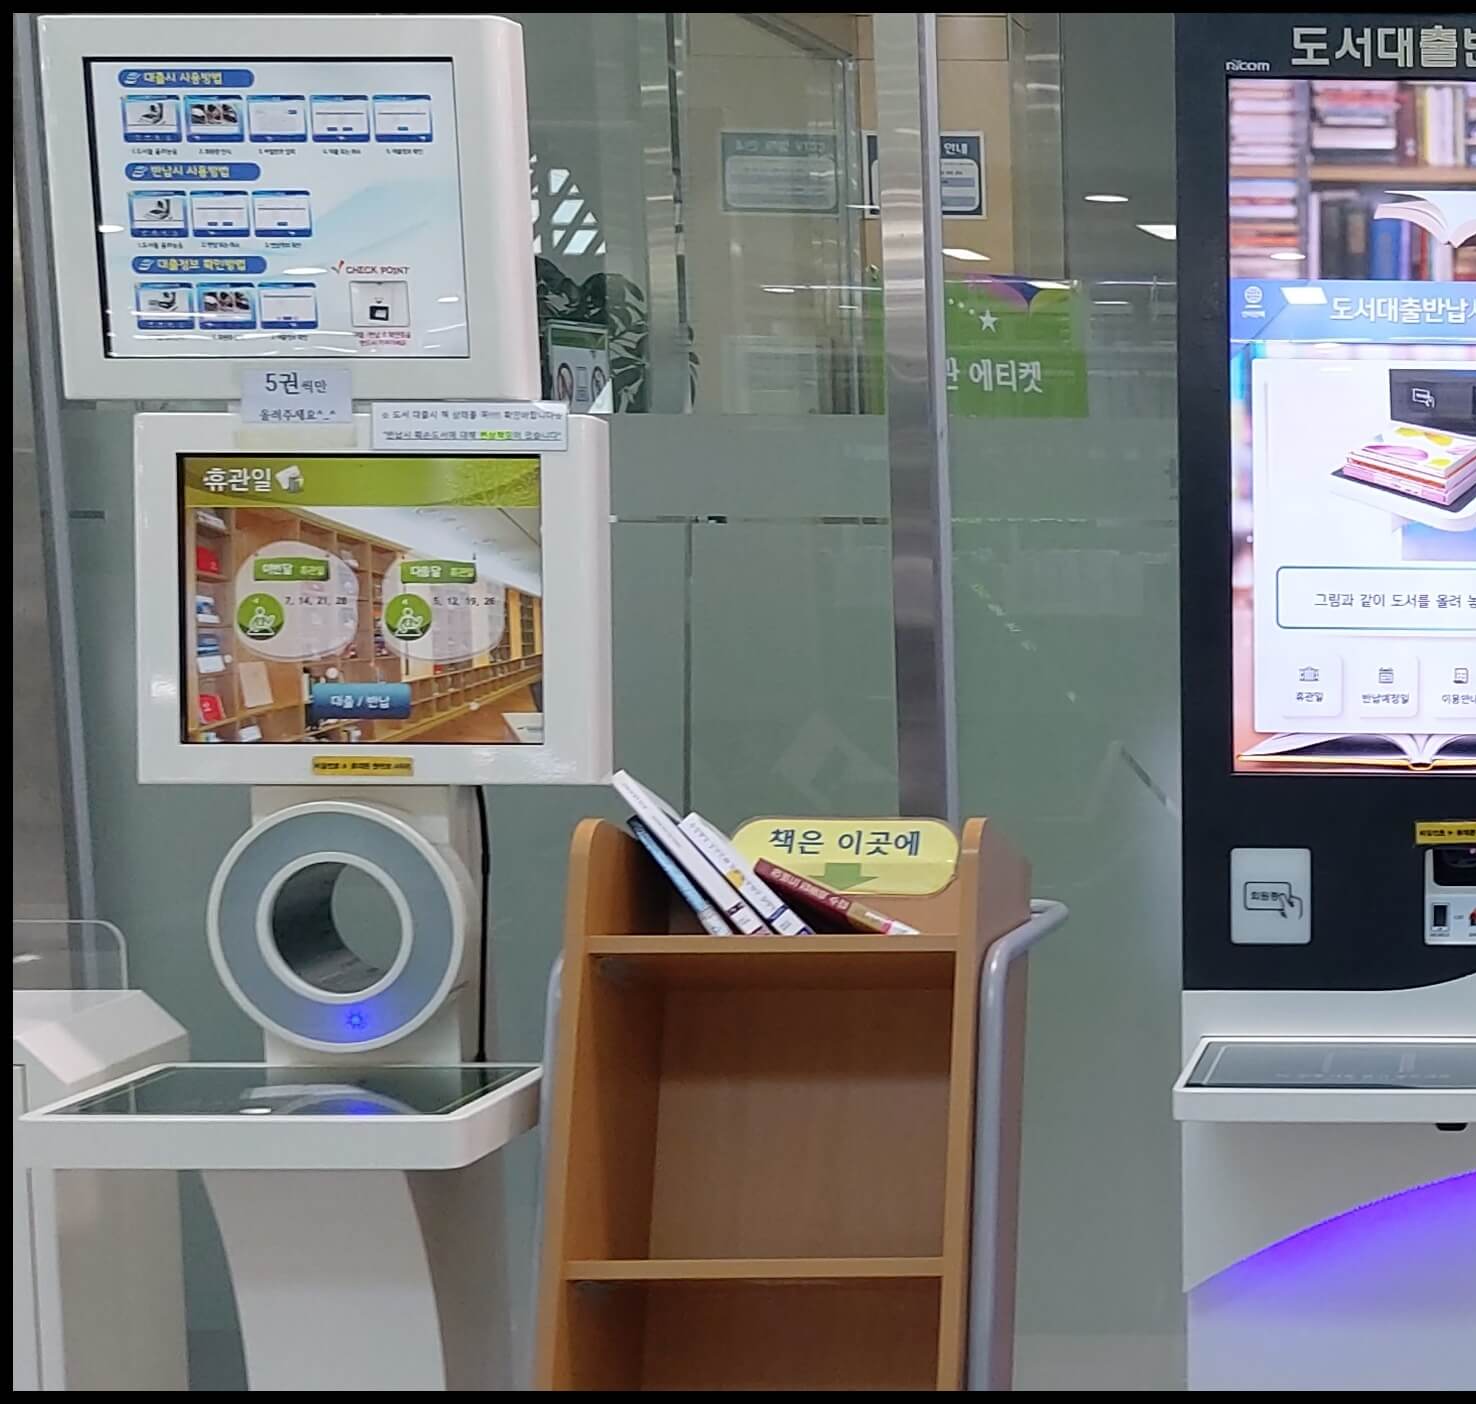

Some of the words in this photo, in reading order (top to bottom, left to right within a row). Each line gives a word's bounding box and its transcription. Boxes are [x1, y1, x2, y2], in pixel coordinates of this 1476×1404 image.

[944, 143, 967, 155] 안내
[346, 266, 378, 274] CHECK
[381, 266, 410, 274] POINT
[969, 358, 1043, 393] 에티켓
[204, 467, 272, 492] 휴관일
[1314, 594, 1354, 608] 그림과
[1360, 594, 1385, 608] 같이
[1391, 594, 1430, 609] 도서를
[1435, 594, 1461, 609] 올려
[331, 695, 354, 709] 대출
[366, 695, 391, 709] 반납
[768, 829, 825, 855] 책은
[837, 829, 921, 857] 이곳에
